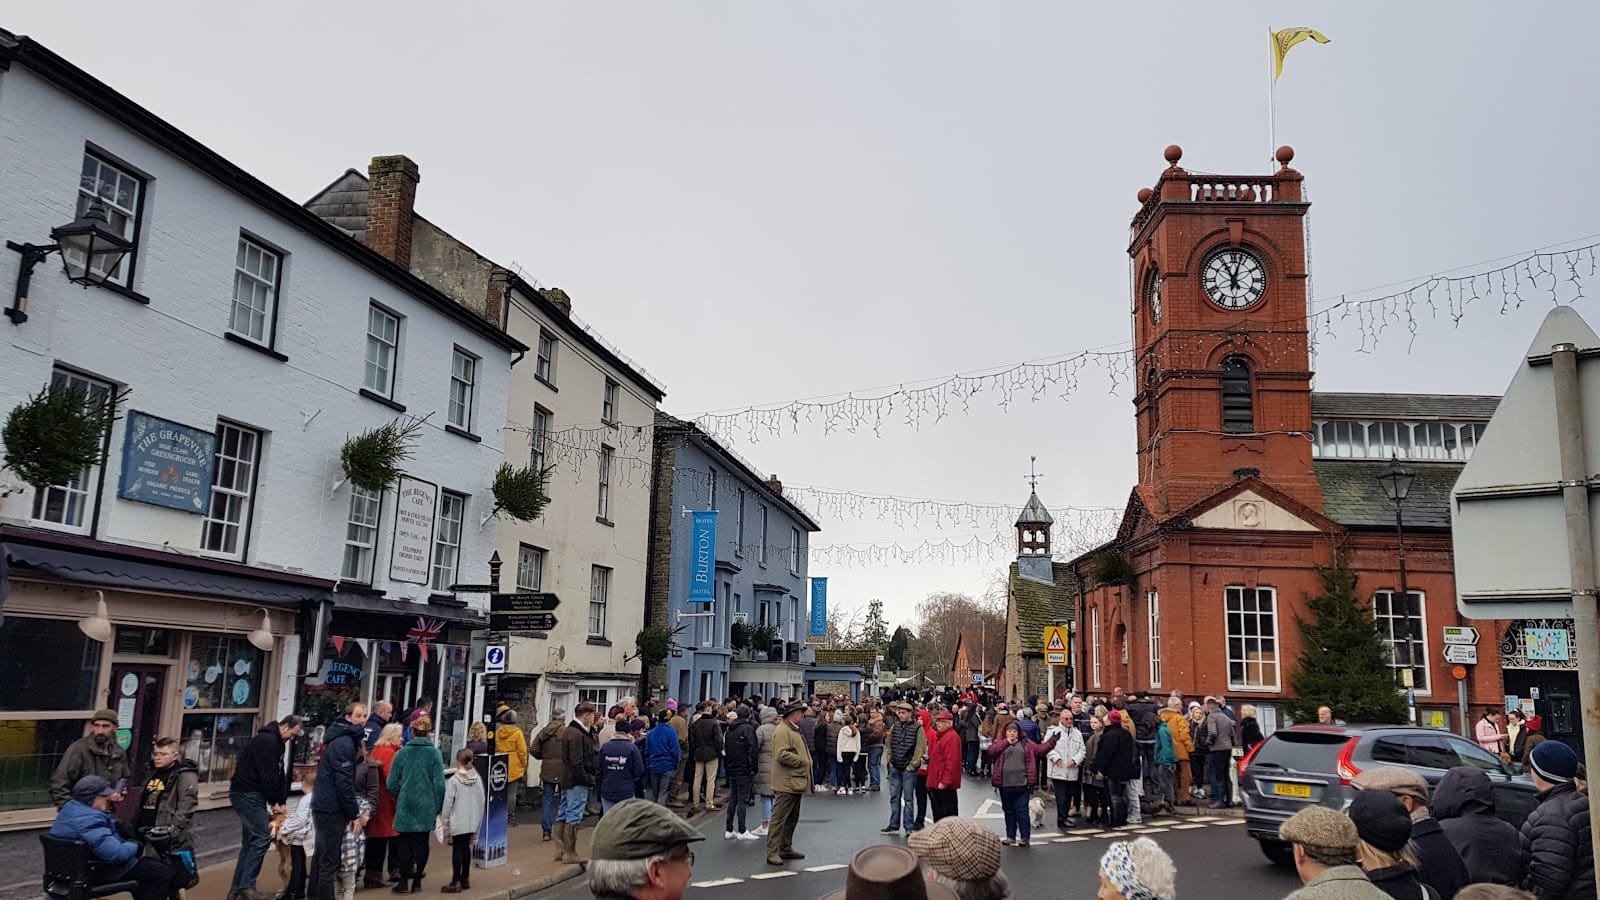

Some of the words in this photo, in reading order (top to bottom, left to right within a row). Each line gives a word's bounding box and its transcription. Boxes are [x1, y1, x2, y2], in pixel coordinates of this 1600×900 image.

[137, 432, 157, 453] THE
[160, 430, 207, 467] GRAPEVINE
[151, 448, 196, 466] GREENGROCER
[402, 488, 412, 498] THE
[414, 488, 433, 505] REGENCY
[326, 674, 347, 684] CAFE
[328, 662, 364, 680] REGENCY
